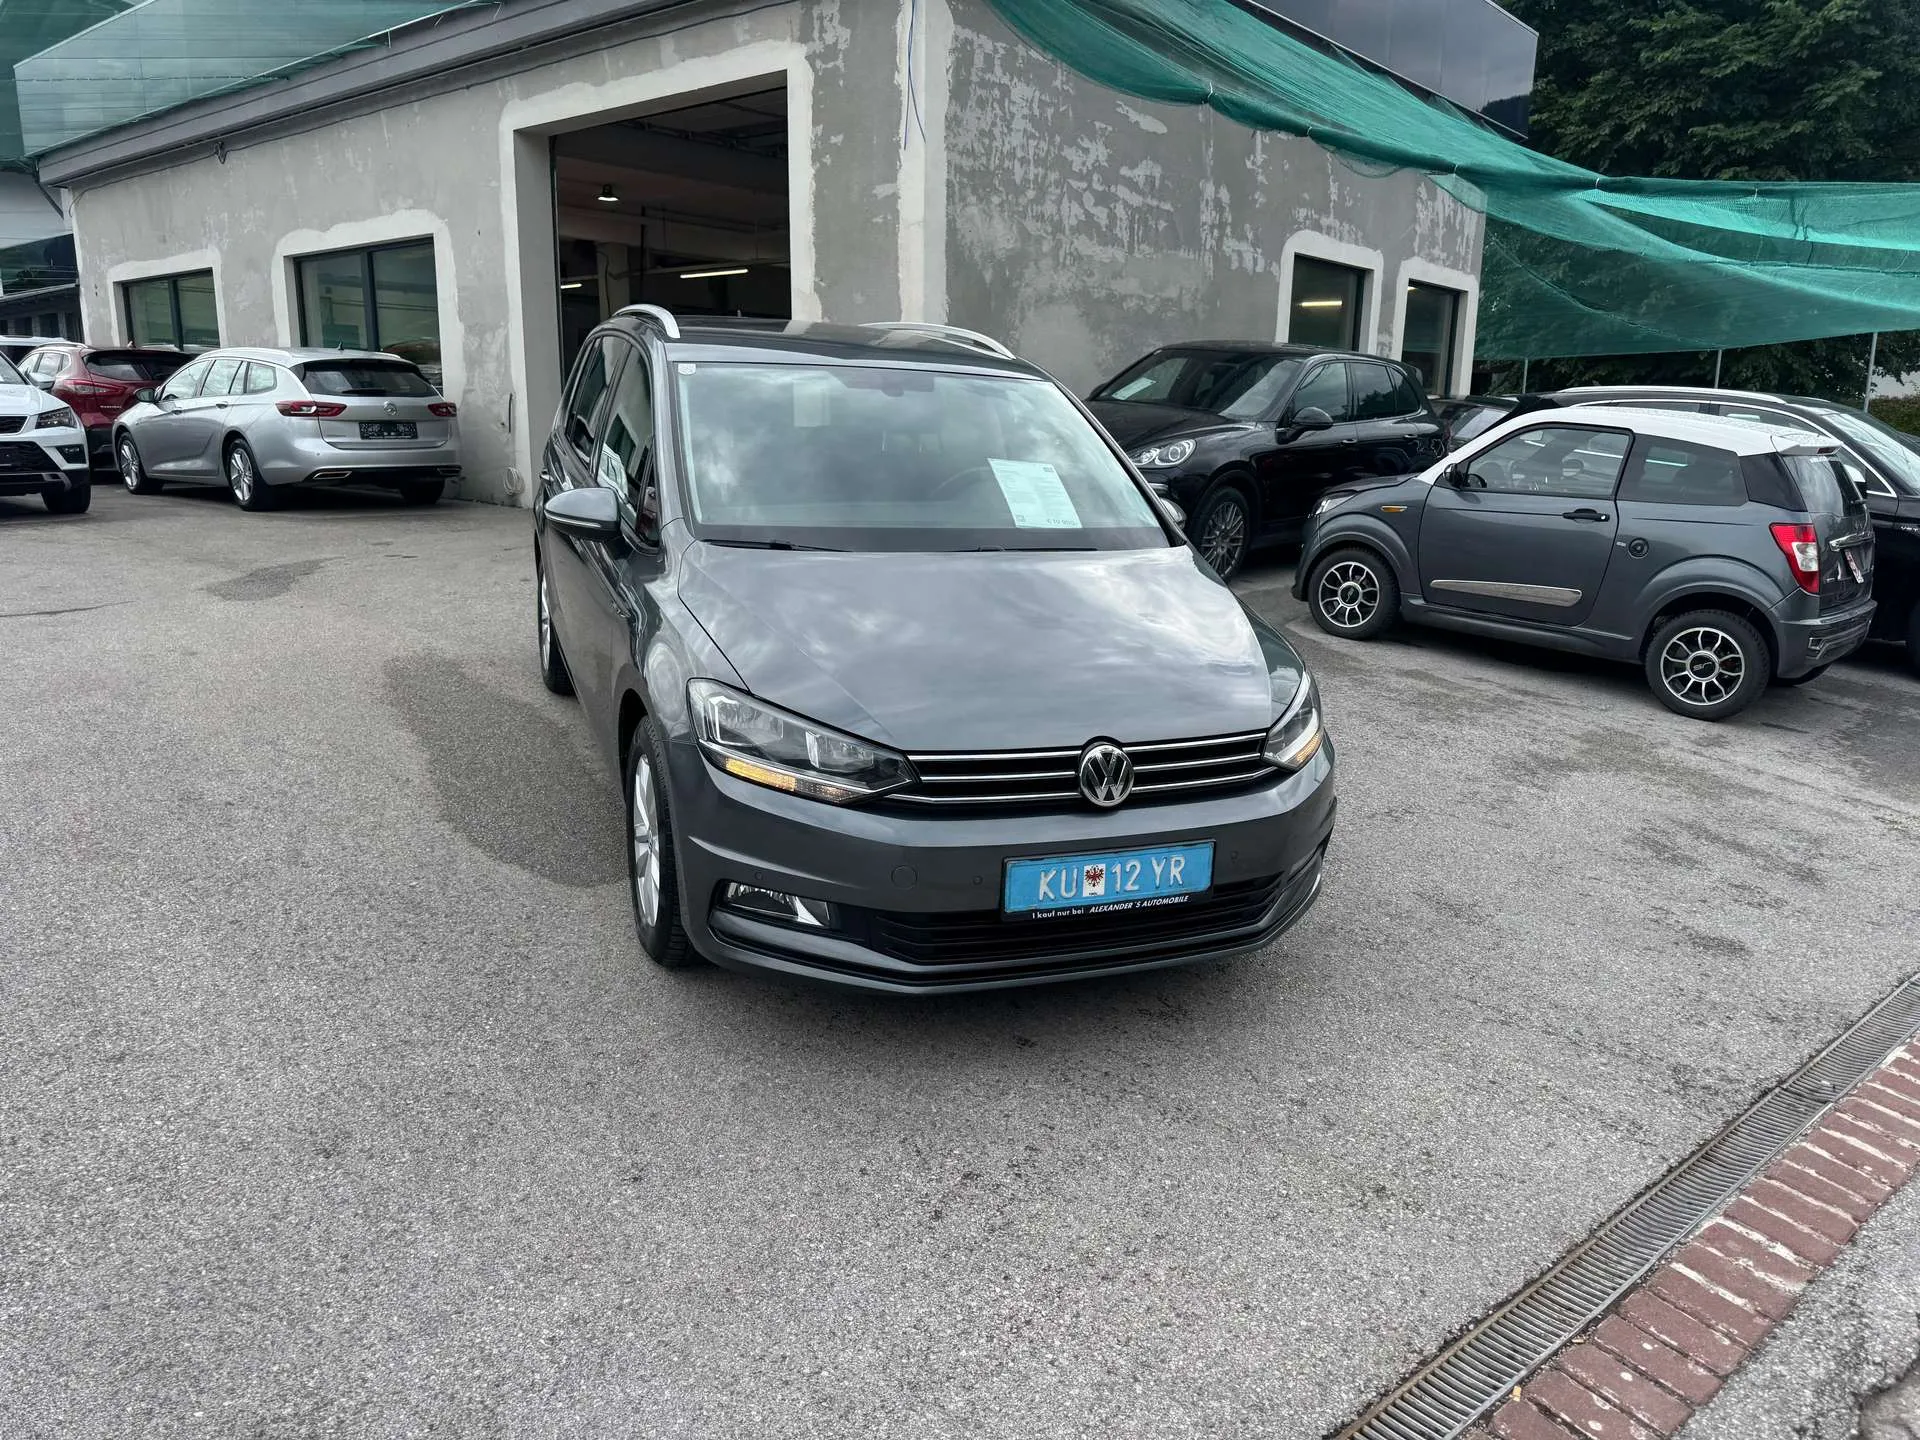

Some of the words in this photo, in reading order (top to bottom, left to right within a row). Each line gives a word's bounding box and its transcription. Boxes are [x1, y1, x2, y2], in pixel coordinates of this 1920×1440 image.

[1083, 747, 1131, 803] VW
[1039, 865, 1078, 901] KU
[1111, 859, 1142, 893] 12
[1151, 855, 1186, 889] YR
[1037, 910, 1056, 918] kauf
[1072, 907, 1084, 915] bei
[1089, 901, 1133, 913] ALEXANDER
[1141, 895, 1190, 907] AUTOMOBILE
